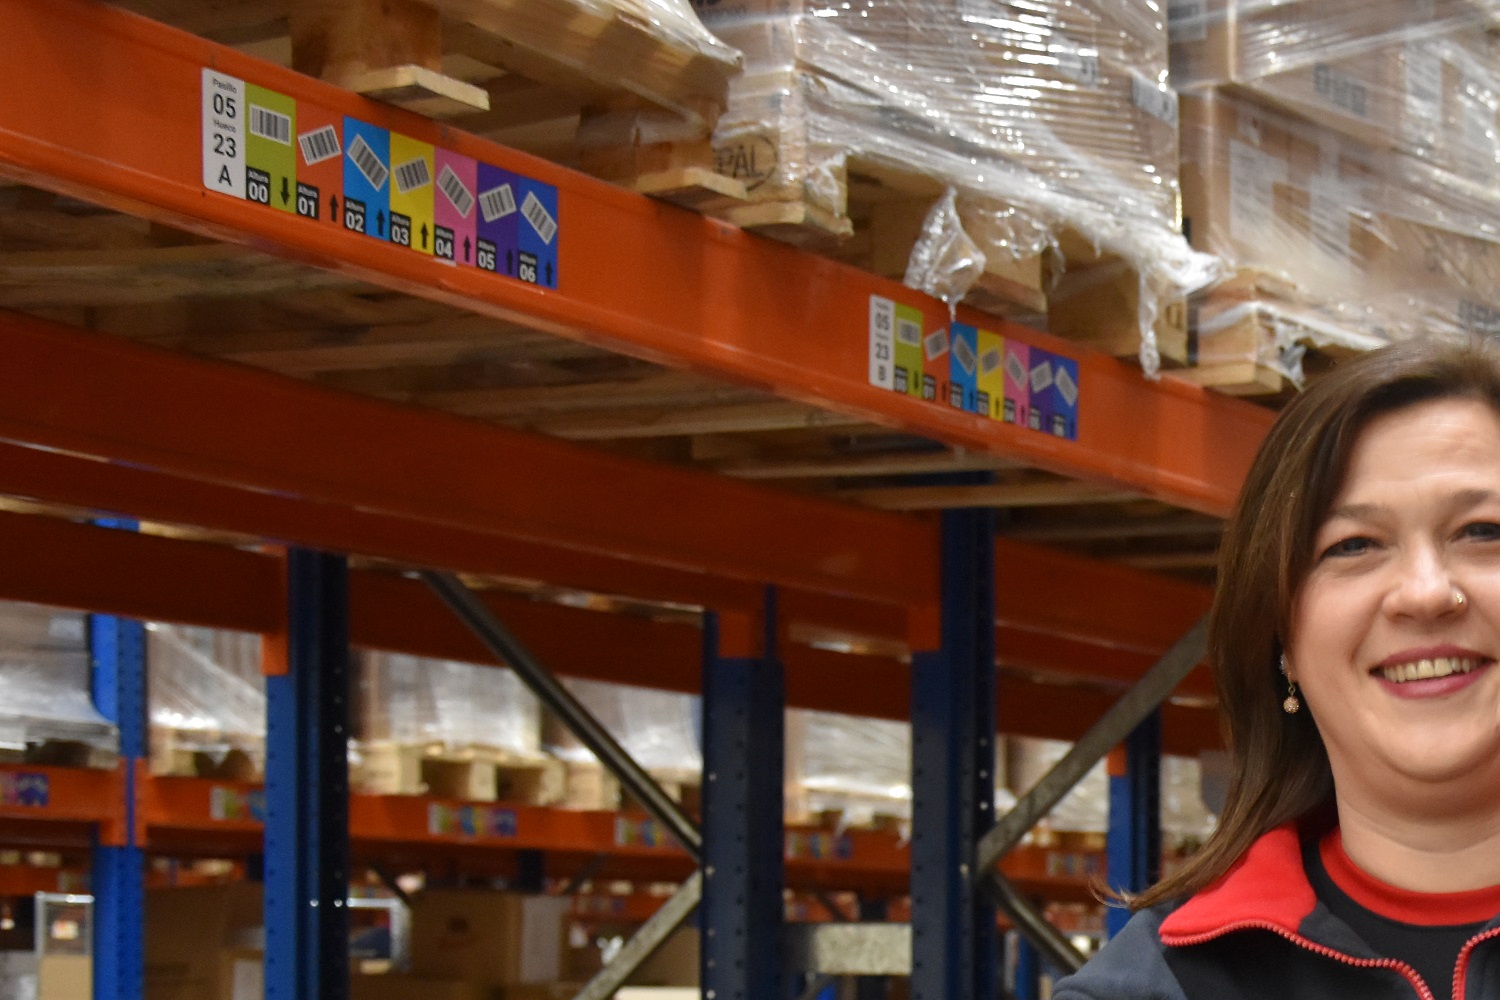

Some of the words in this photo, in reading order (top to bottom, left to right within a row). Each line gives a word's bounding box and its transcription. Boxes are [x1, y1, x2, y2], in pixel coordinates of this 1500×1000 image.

[212, 78, 237, 94] Pasillo
[213, 94, 236, 119] 05
[213, 134, 236, 159] 23
[218, 164, 232, 187] A
[248, 182, 268, 204] 00
[298, 196, 316, 217] 01
[345, 212, 364, 233] 02
[391, 226, 409, 245] 03
[436, 239, 453, 258] 04
[478, 251, 496, 270] 05
[519, 265, 536, 283] 06
